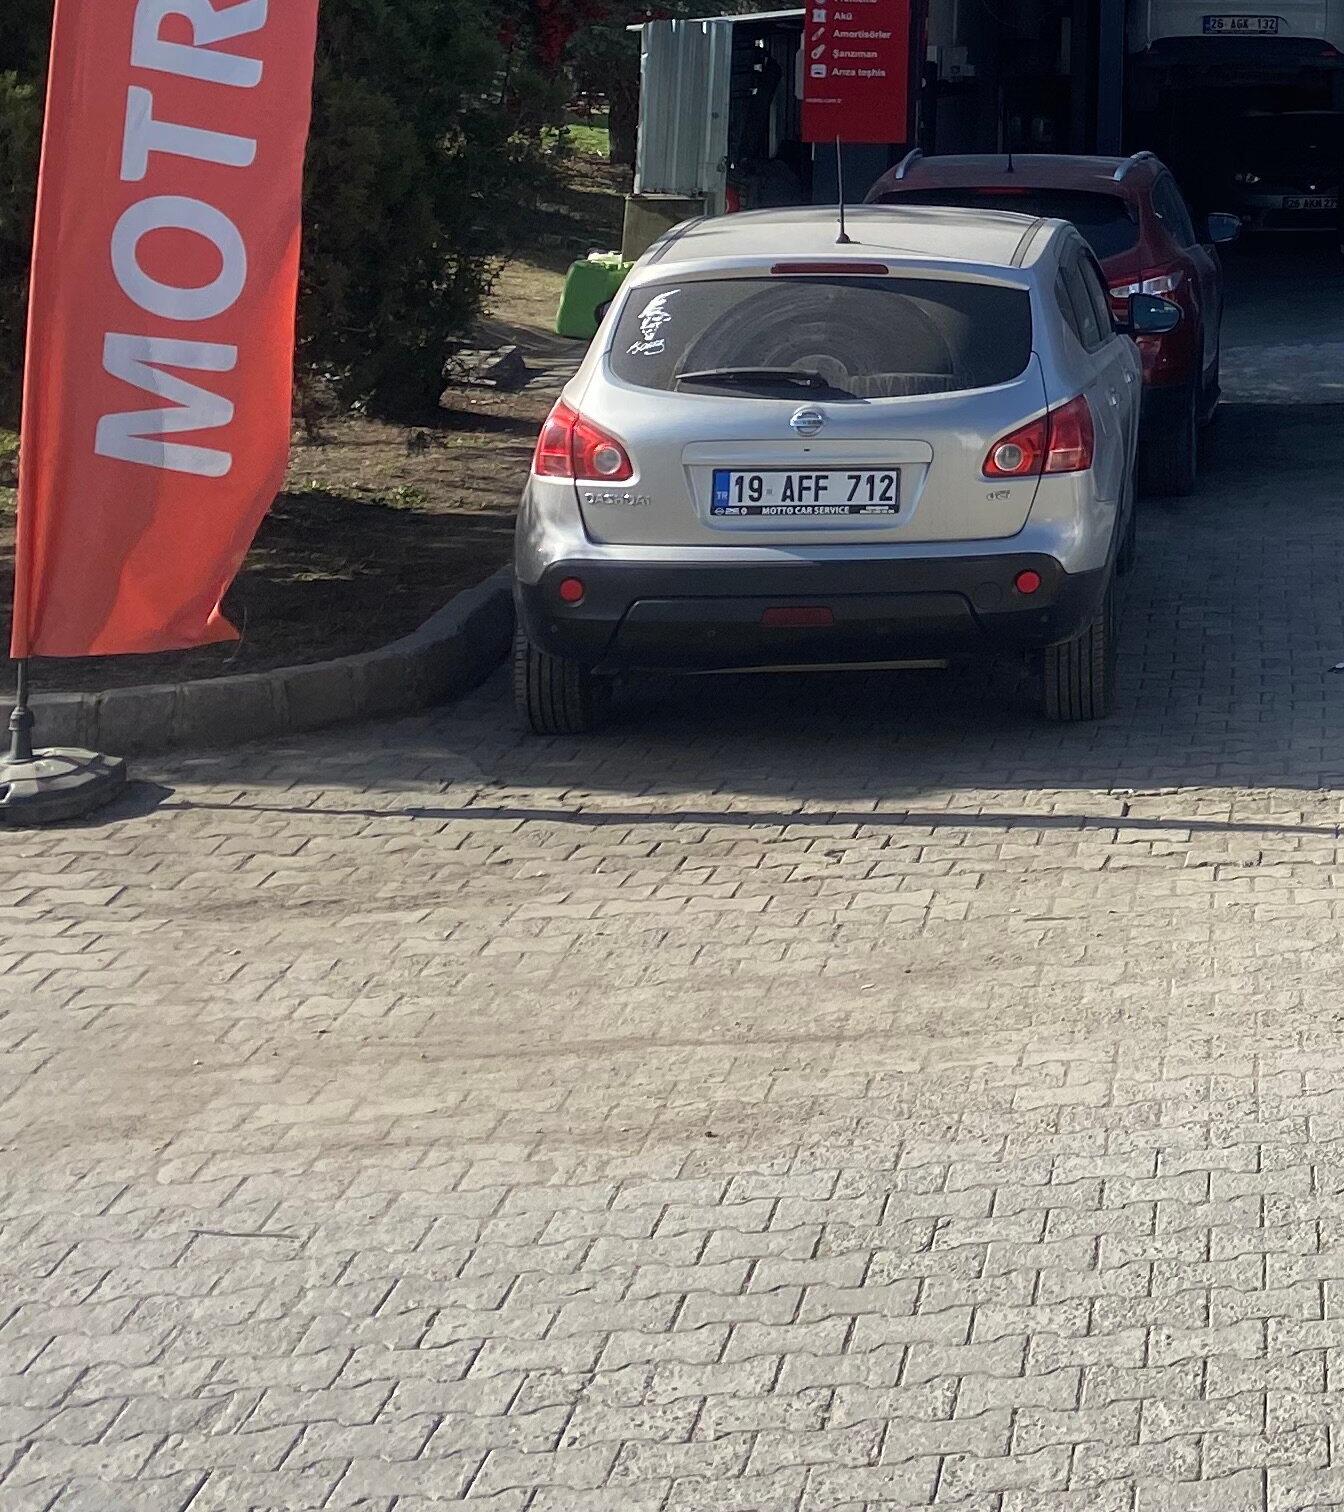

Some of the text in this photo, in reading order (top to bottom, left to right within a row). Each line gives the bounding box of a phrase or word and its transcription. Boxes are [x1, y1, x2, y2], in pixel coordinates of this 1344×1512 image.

[833, 11, 853, 20] Akü
[1211, 19, 1224, 29] 26
[1258, 19, 1275, 29] 132
[833, 29, 892, 39] Amortisörler
[735, 474, 894, 503] 19 AFF 712
[716, 491, 728, 500] TR
[762, 507, 793, 515] MOTTO
[795, 506, 812, 515] CAR
[813, 506, 850, 515] SERVICE
